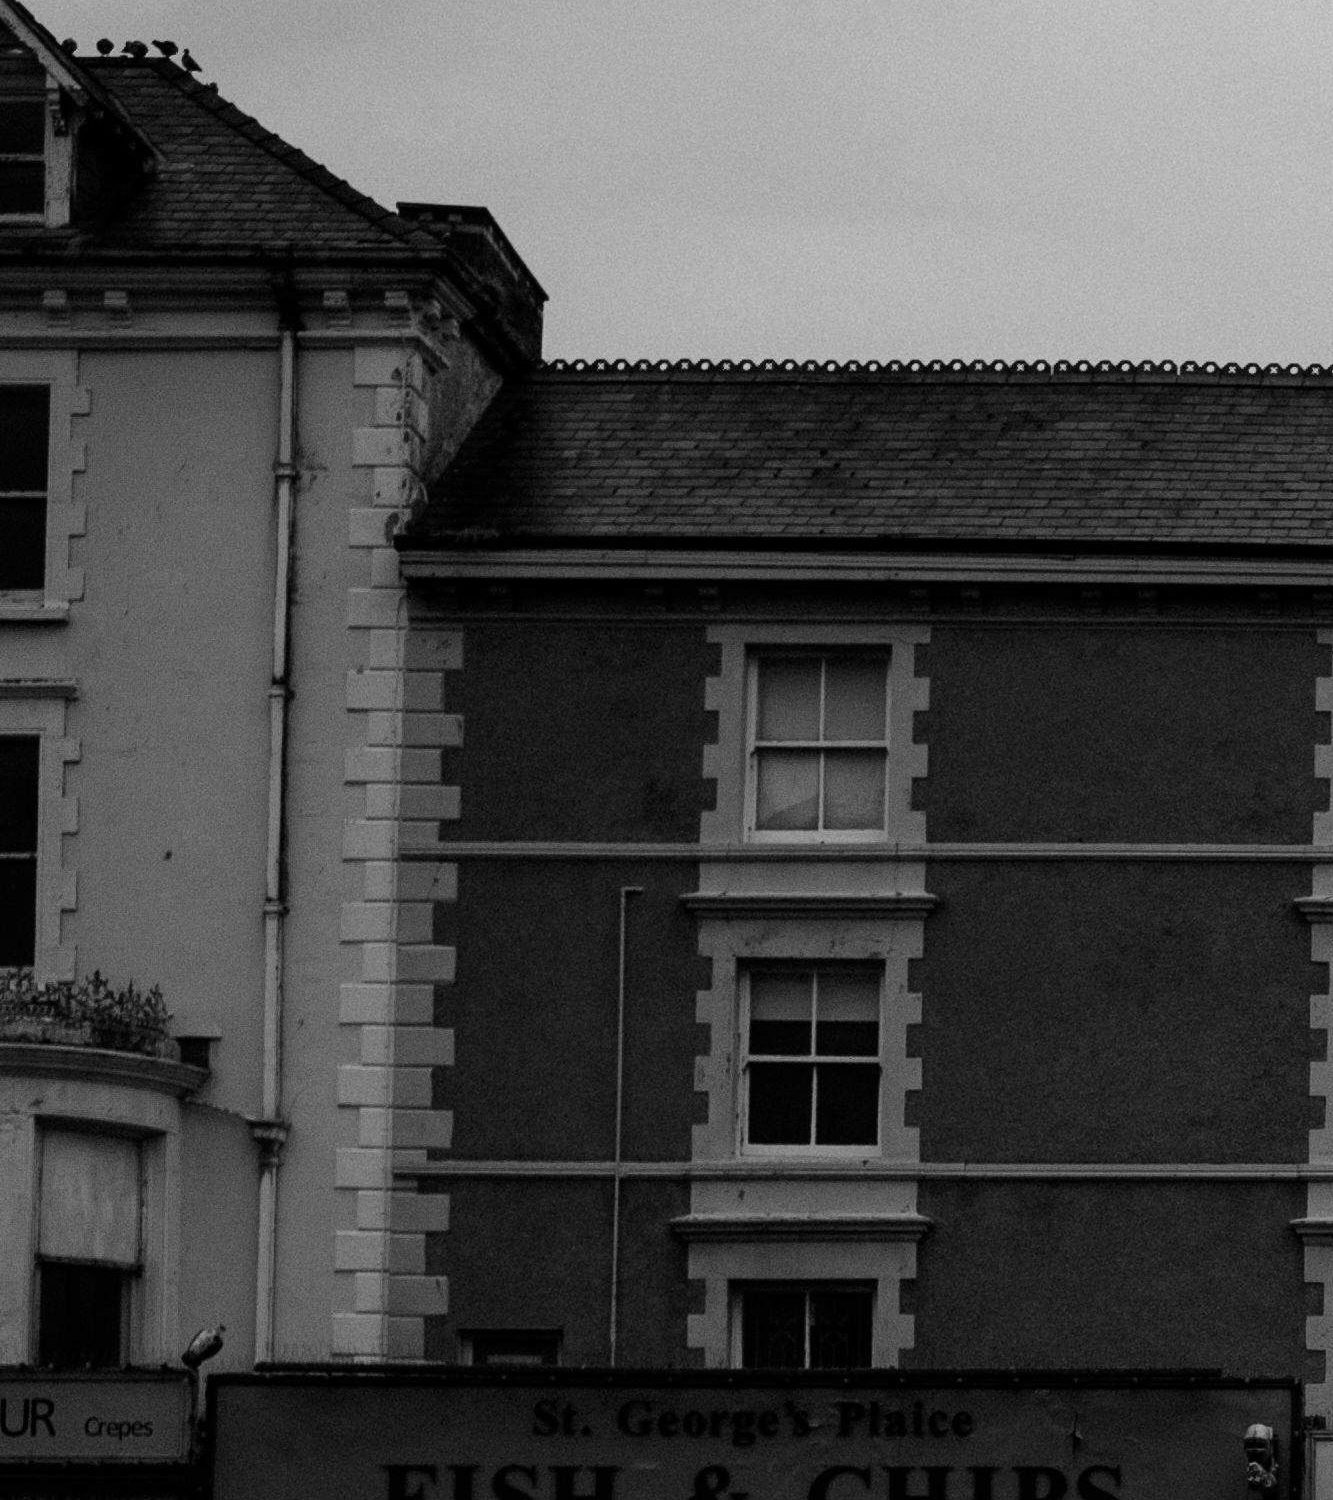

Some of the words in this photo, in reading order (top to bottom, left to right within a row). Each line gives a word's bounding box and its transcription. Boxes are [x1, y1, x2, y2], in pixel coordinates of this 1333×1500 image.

[84, 1416, 154, 1441] Crepes
[532, 1400, 591, 1438] St.
[617, 1400, 812, 1448] George's
[836, 1401, 974, 1438] Plaice
